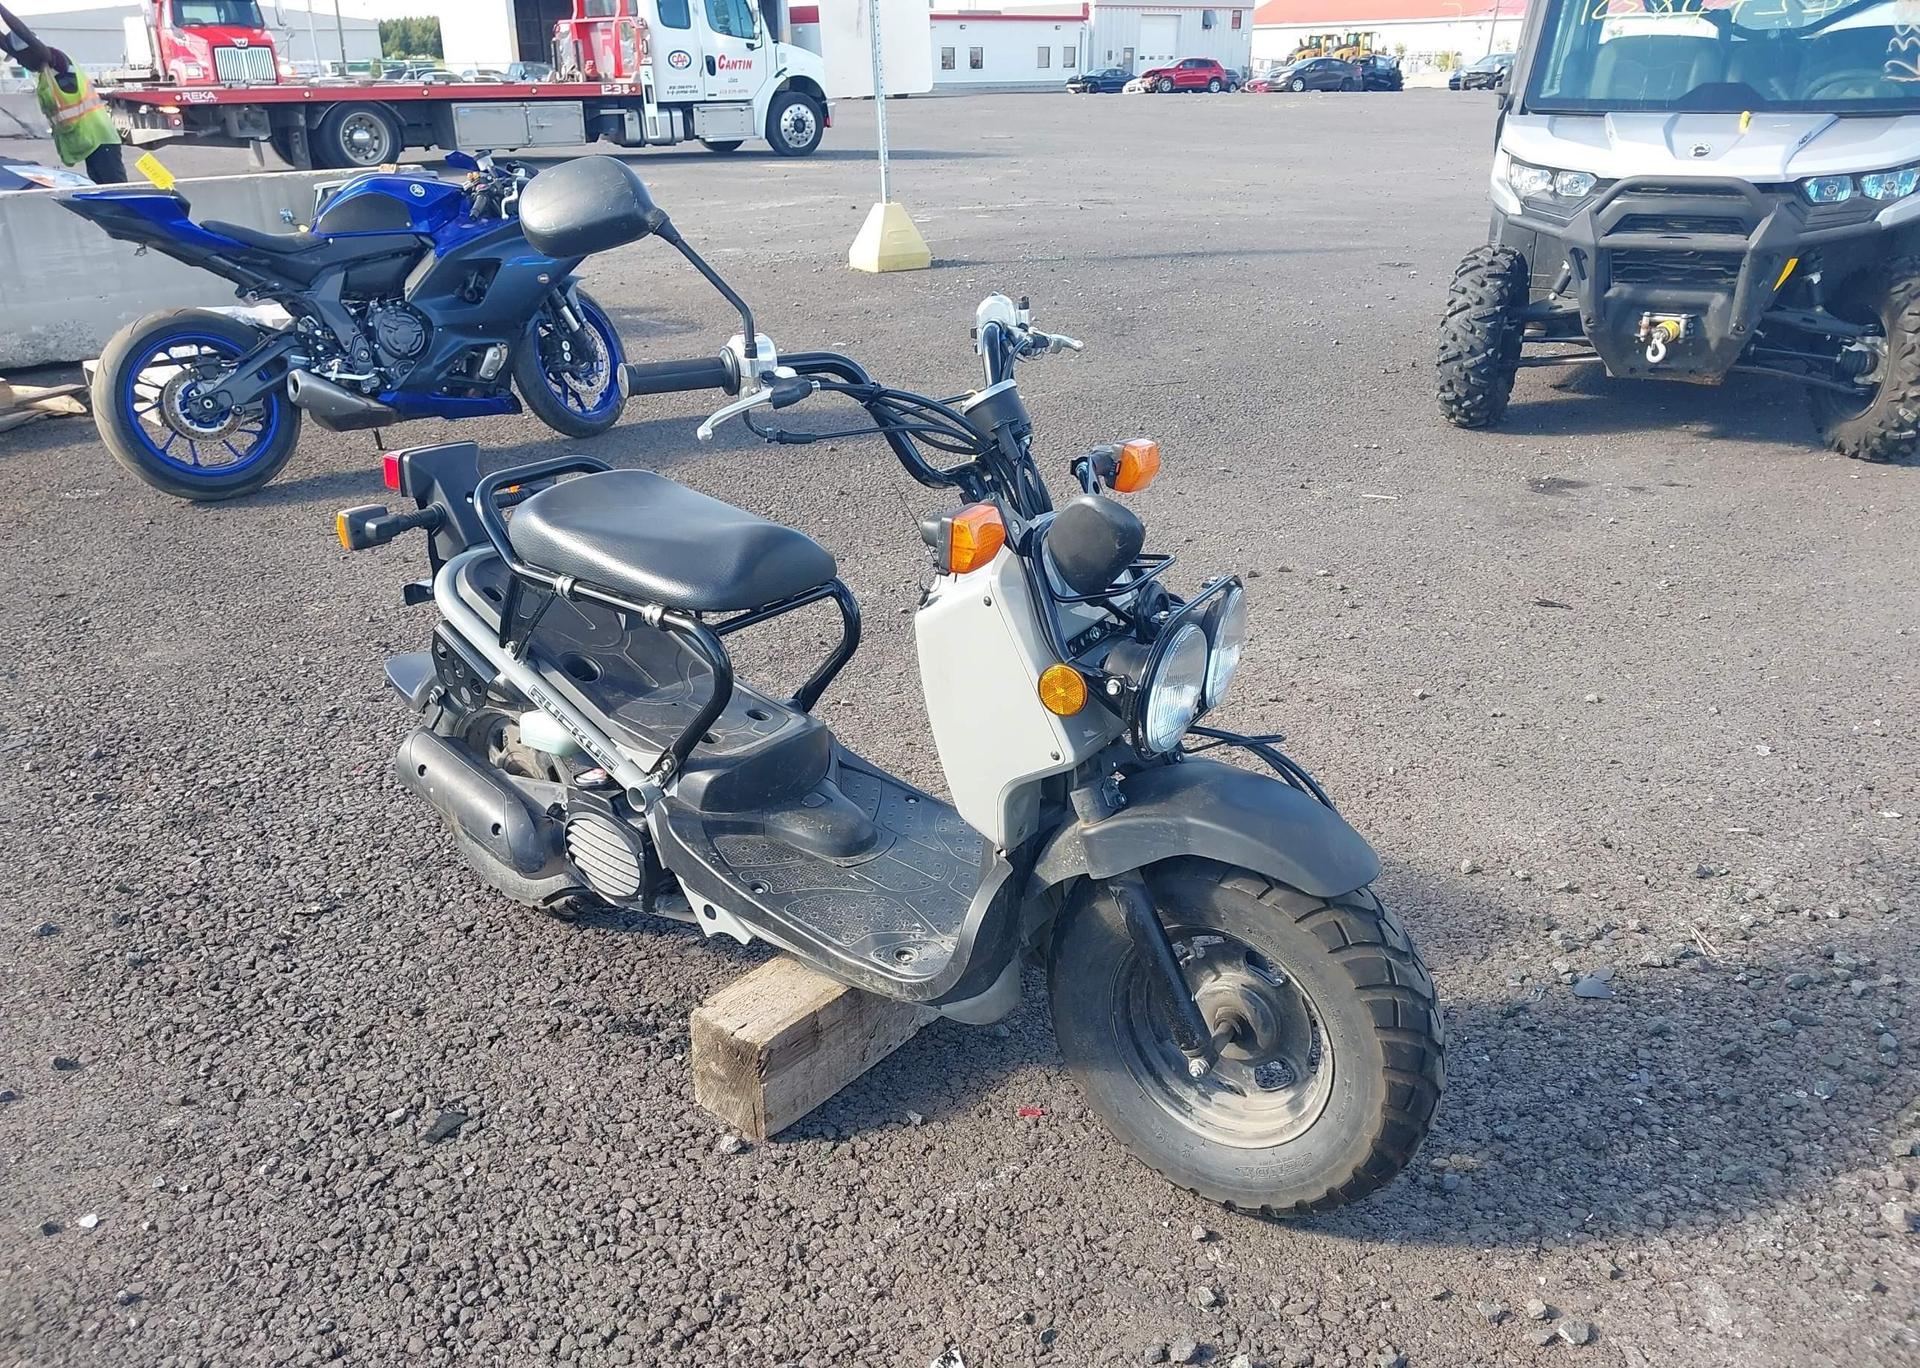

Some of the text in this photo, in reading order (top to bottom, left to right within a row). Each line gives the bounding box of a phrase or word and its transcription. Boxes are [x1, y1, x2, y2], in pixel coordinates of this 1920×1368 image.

[671, 53, 688, 66] CAA
[718, 54, 753, 70] CANTIN
[181, 91, 216, 102] REKA
[529, 687, 617, 772] RUCKUS
